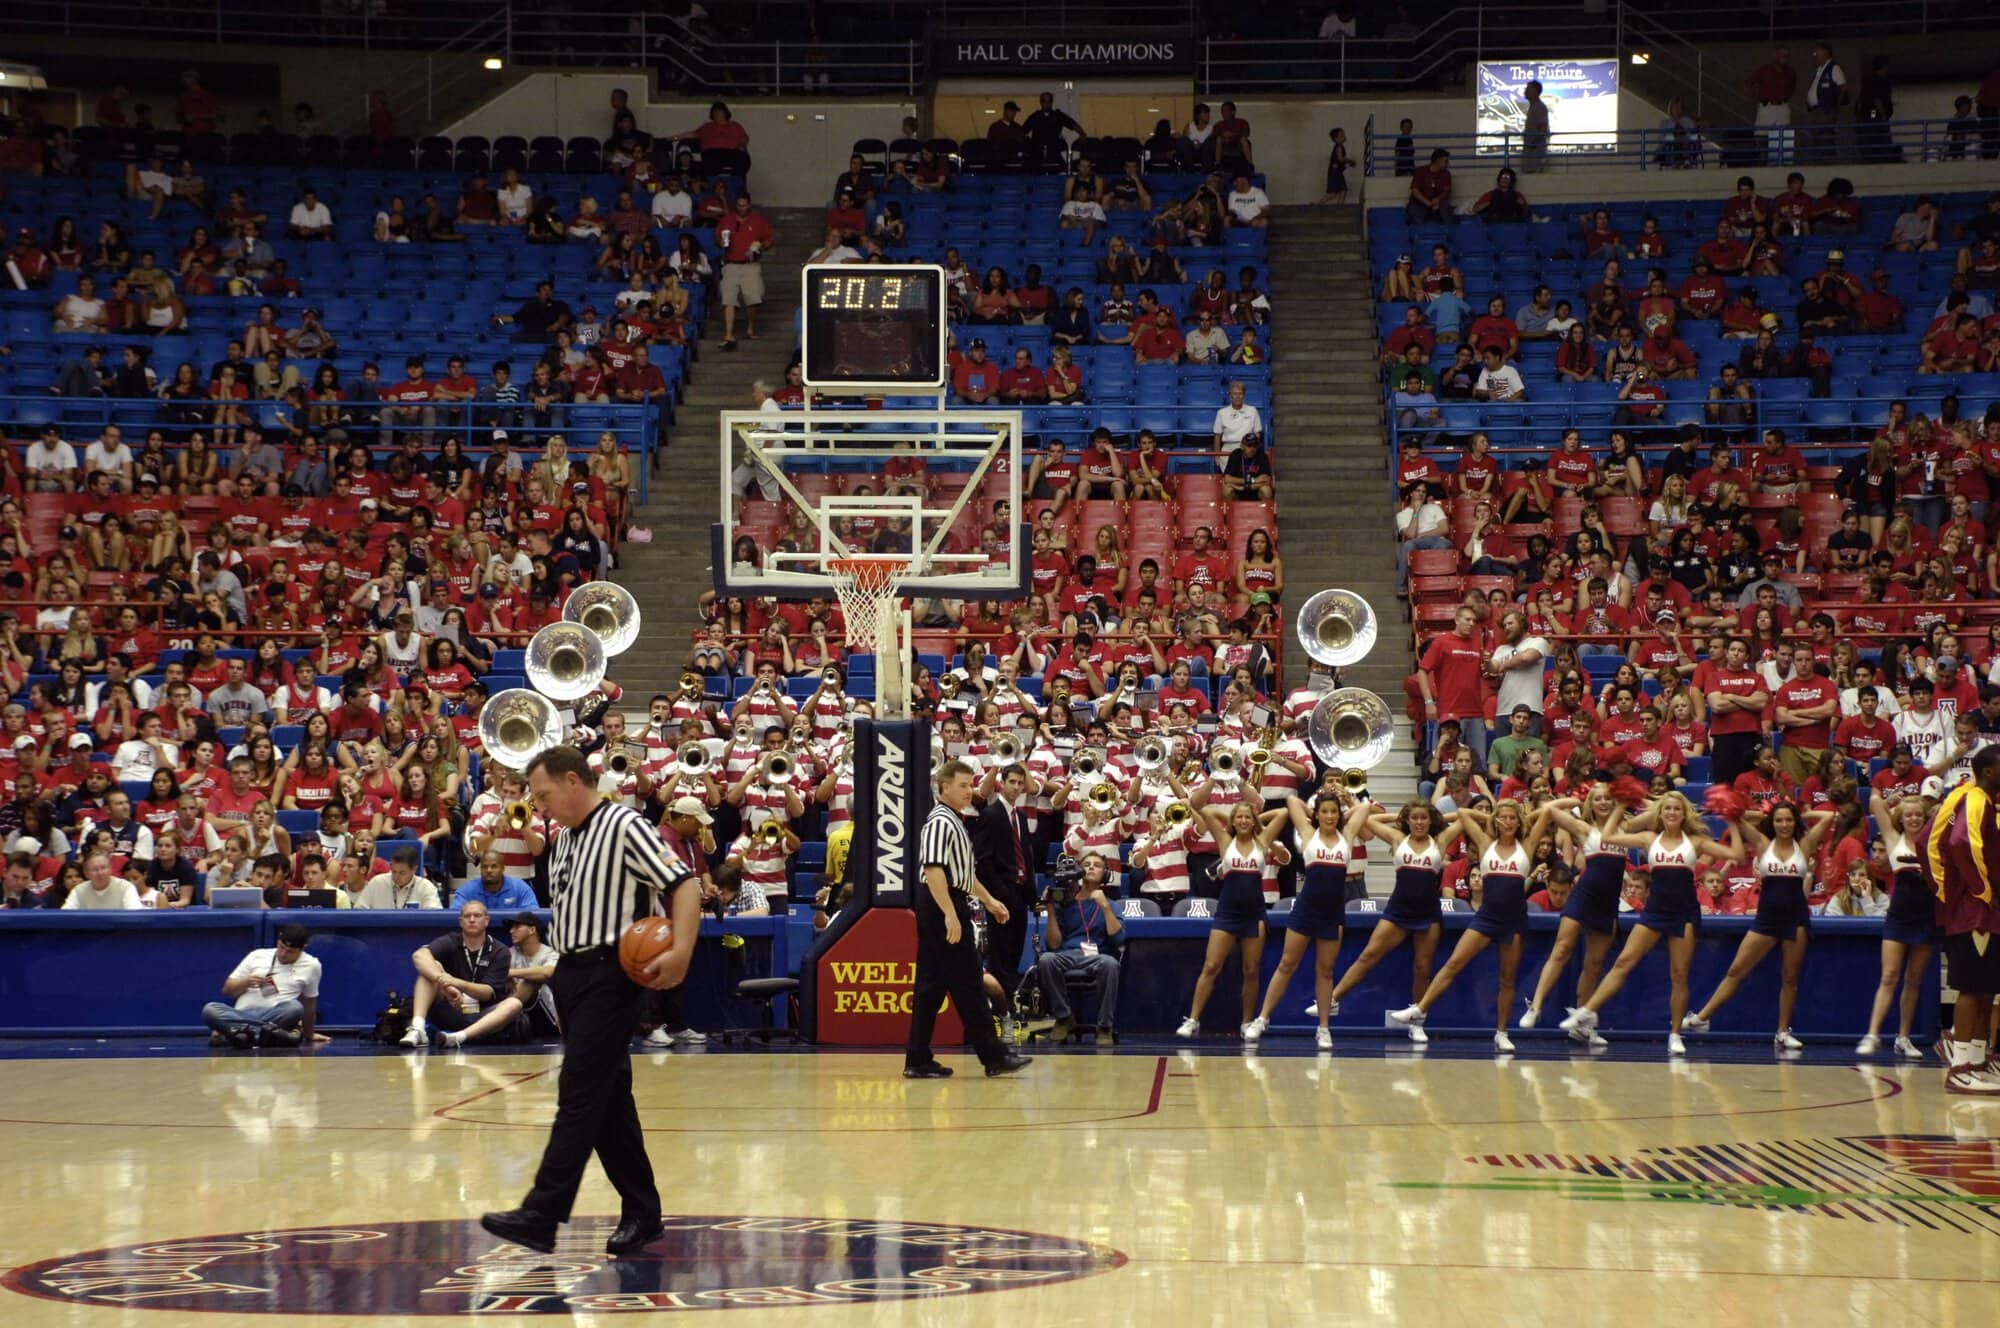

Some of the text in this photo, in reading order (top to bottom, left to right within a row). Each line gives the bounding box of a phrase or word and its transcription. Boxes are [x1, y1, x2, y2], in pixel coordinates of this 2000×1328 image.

[957, 43, 1175, 61] HALL OF CHAMPIONS
[1510, 66, 1535, 80] The
[876, 733, 905, 892] ARIZONA
[834, 991, 949, 1014] FARG
[40, 1229, 389, 1301] COURT
